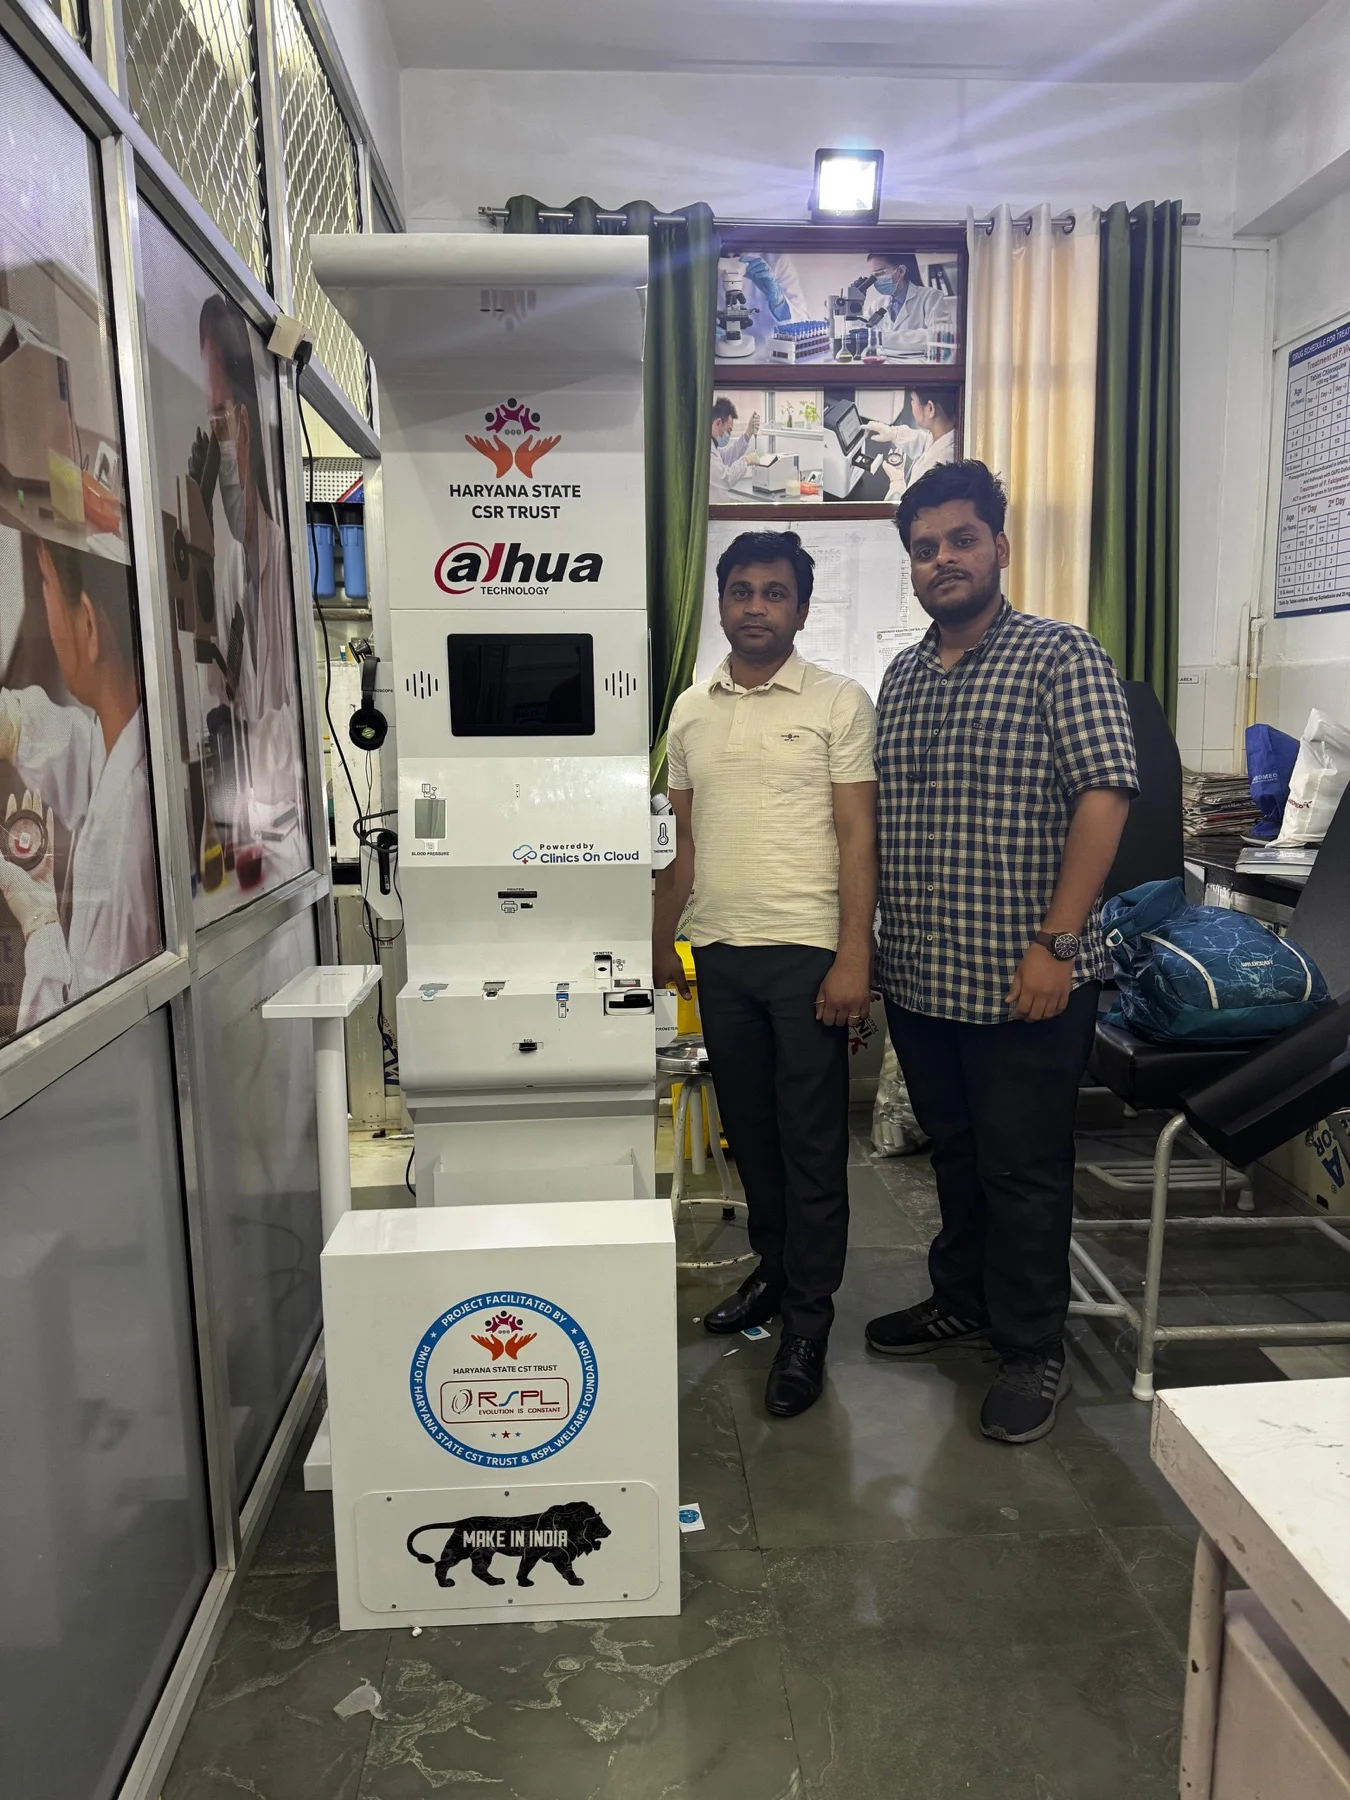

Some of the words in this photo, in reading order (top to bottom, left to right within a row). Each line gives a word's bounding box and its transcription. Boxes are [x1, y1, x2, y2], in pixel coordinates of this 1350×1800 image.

[1292, 348, 1304, 361] DRUG
[1304, 338, 1326, 356] SCHEDULE
[1327, 333, 1336, 344] FOR
[1308, 353, 1332, 371] Treatment
[449, 484, 529, 498] HARYANA
[531, 484, 581, 498] STATE
[471, 505, 504, 519] CSR
[507, 505, 561, 519] TRUST
[1308, 505, 1318, 514] Day
[1335, 498, 1346, 507] Day
[1286, 515, 1295, 523] Age
[480, 586, 550, 596] TECHNOLOGY
[540, 853, 580, 864] Clinics
[583, 852, 601, 862] On
[604, 851, 640, 861] Cloud
[441, 1298, 484, 1327] PROJECT
[485, 1294, 552, 1315] FACILITATED
[552, 1309, 568, 1323] BY
[415, 1344, 431, 1369] PMU
[414, 1370, 423, 1385] OF
[453, 1366, 491, 1375] HARYANA
[492, 1366, 517, 1374] STATE
[518, 1365, 533, 1373] CST
[578, 1341, 596, 1408] FOUNDATION
[478, 1390, 560, 1408] RSPL
[414, 1385, 439, 1435] HARYANA
[479, 1408, 515, 1416] EVOLUTION
[554, 1408, 589, 1448] WELFARE
[435, 1431, 464, 1456] STATE
[464, 1451, 483, 1463] CST
[486, 1455, 519, 1466] TRUST
[521, 1456, 529, 1464] &
[531, 1445, 556, 1462] RSPL
[463, 1530, 506, 1548] MAKE
[510, 1530, 525, 1548] IN
[529, 1530, 568, 1548] INDIA
